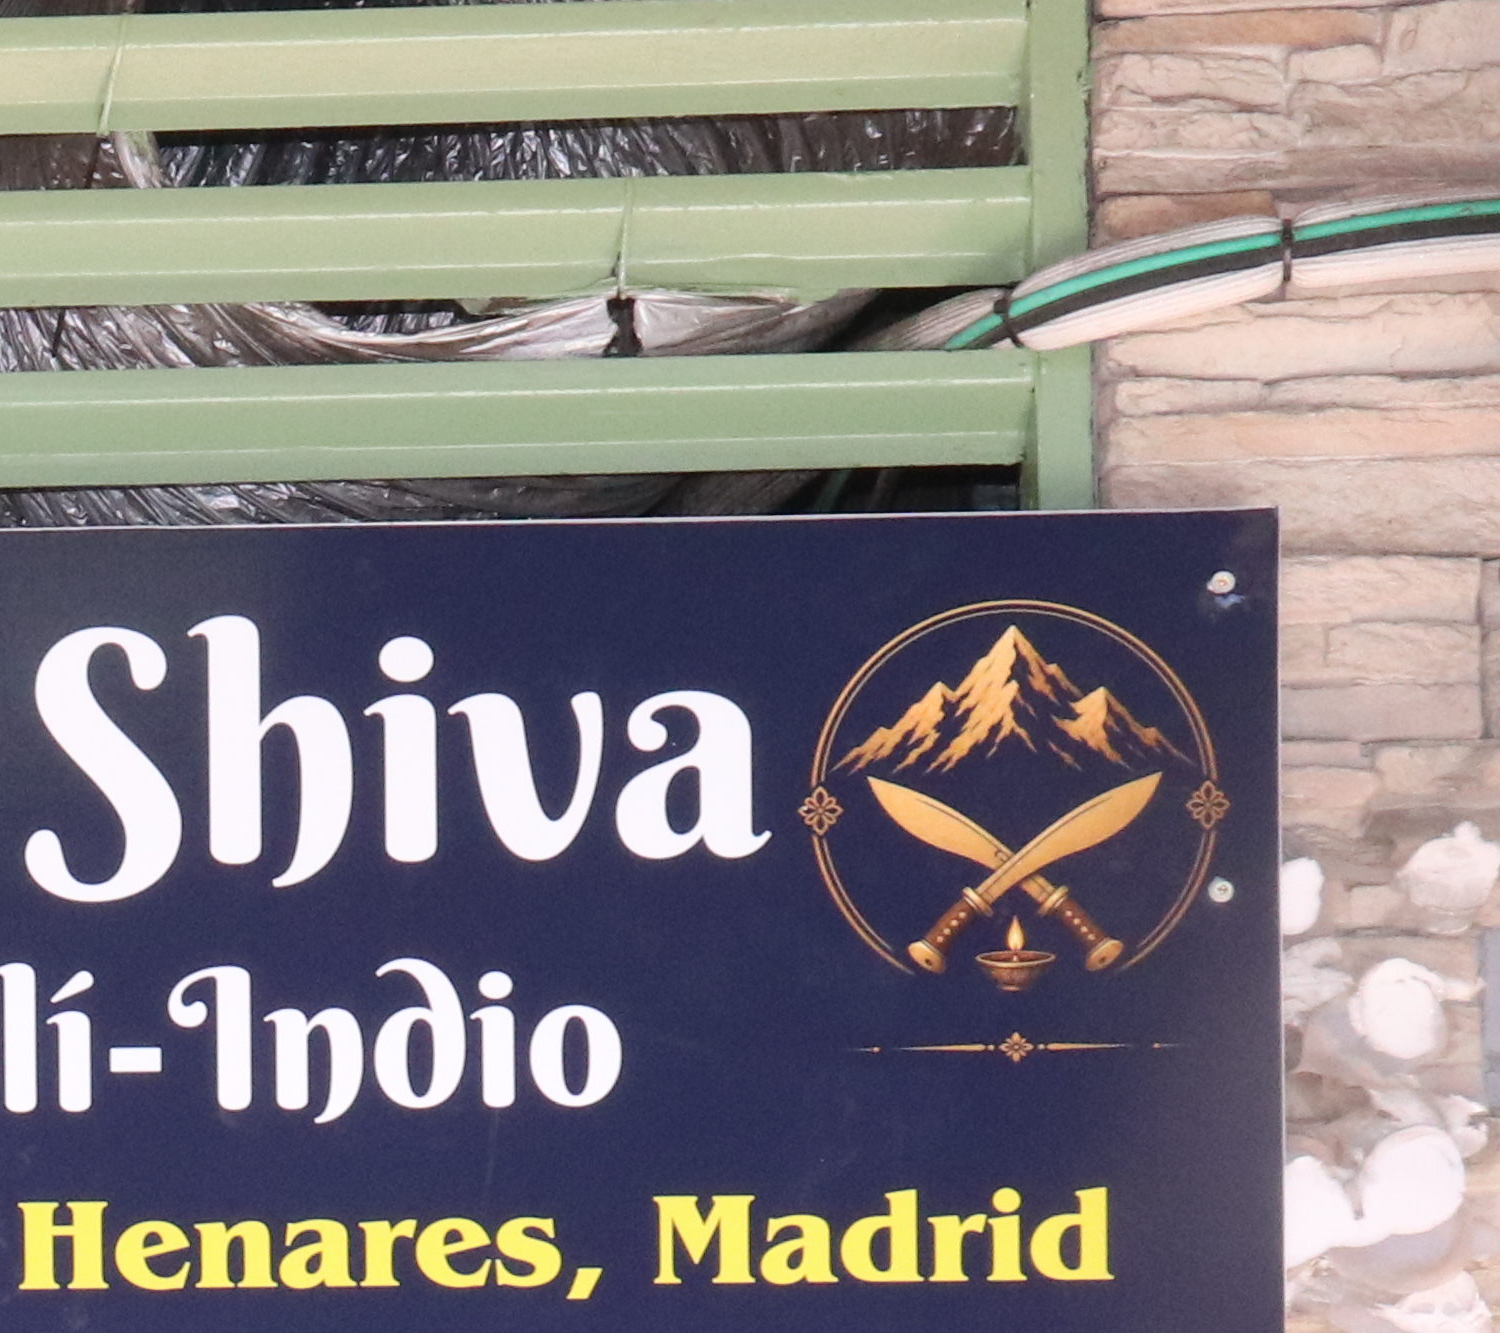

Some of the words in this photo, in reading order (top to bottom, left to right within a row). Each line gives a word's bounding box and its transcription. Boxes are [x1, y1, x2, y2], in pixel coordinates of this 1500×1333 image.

[25, 615, 771, 903] Shiva
[17, 1201, 602, 1300] Henares,
[653, 1187, 1114, 1285] Madrid
